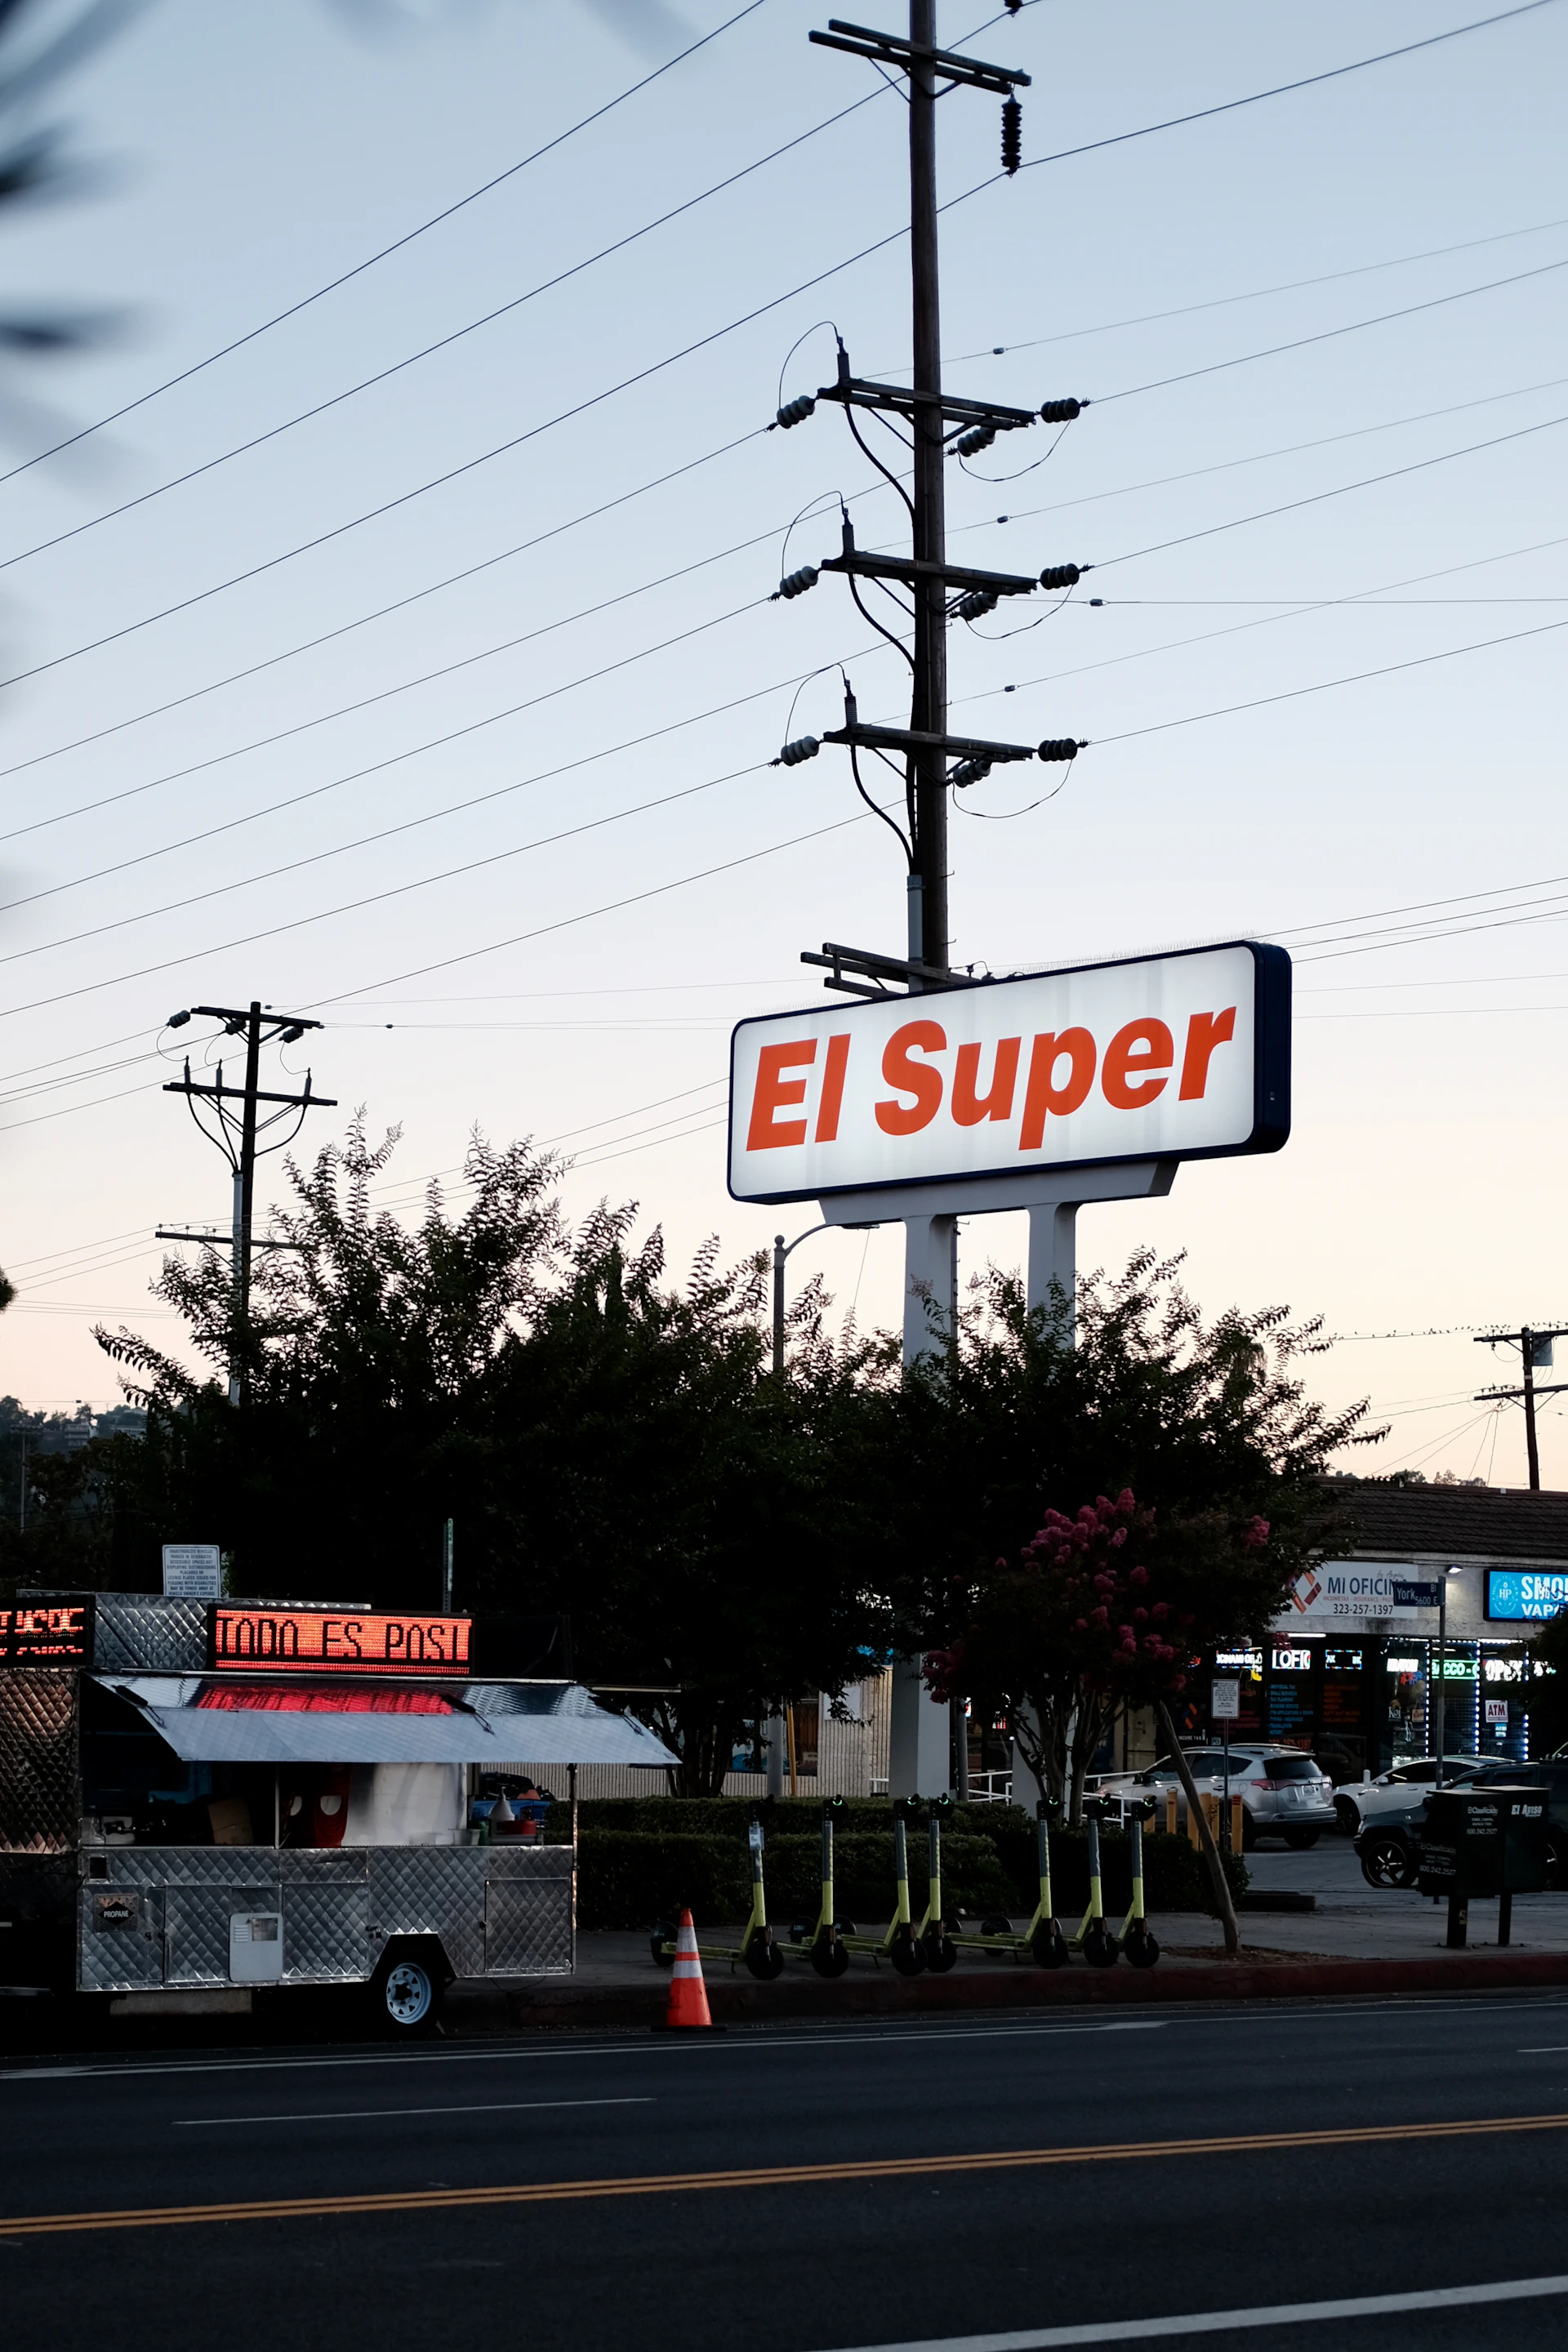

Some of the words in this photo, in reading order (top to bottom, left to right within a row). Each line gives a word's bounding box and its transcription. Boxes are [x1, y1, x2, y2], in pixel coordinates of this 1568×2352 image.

[746, 1032, 851, 1152] El
[874, 1005, 1237, 1151] Super
[1328, 1577, 1345, 1594] MI
[1396, 1587, 1416, 1600] York
[1499, 1588, 1512, 1599] HP
[1414, 1596, 1431, 1606] 5600
[1432, 1596, 1438, 1605] E
[1333, 1603, 1393, 1615] 323-257-1397
[323, 1621, 362, 1660] ES
[1488, 1704, 1505, 1716] ATM
[1511, 1804, 1521, 1815] El
[1521, 1803, 1543, 1816] Aviso
[103, 1909, 129, 1918] PROPANE
